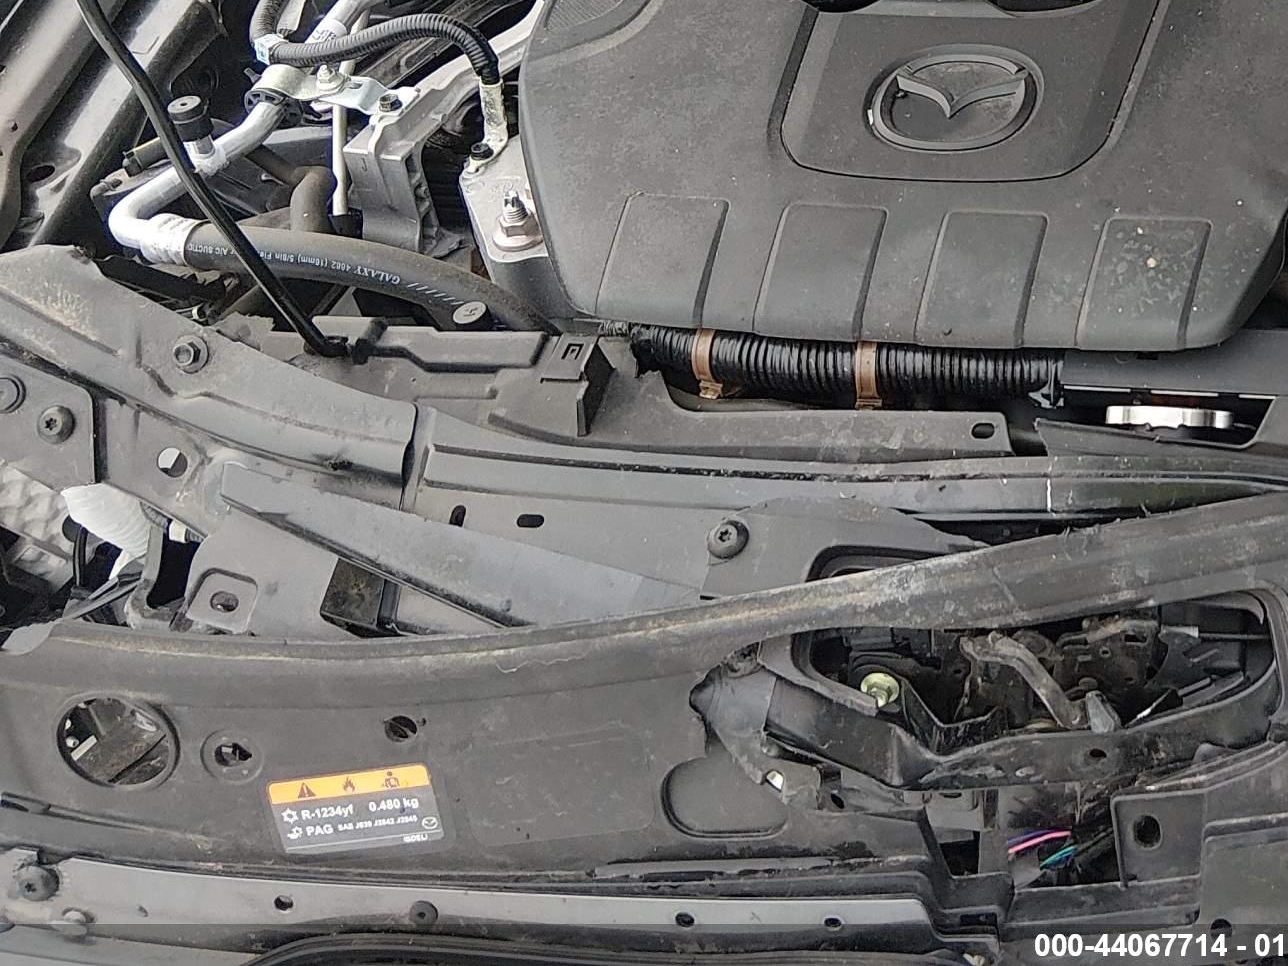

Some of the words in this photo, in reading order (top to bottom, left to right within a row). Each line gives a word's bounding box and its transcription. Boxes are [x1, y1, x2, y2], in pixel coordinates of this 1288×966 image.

[187, 243, 214, 254] SUCTIO
[259, 250, 272, 260] Fle
[353, 266, 401, 284] GALAXY
[301, 804, 354, 821] R-1234yf
[368, 798, 400, 812] 0.480
[402, 797, 419, 809] kg
[306, 824, 334, 837] PAG
